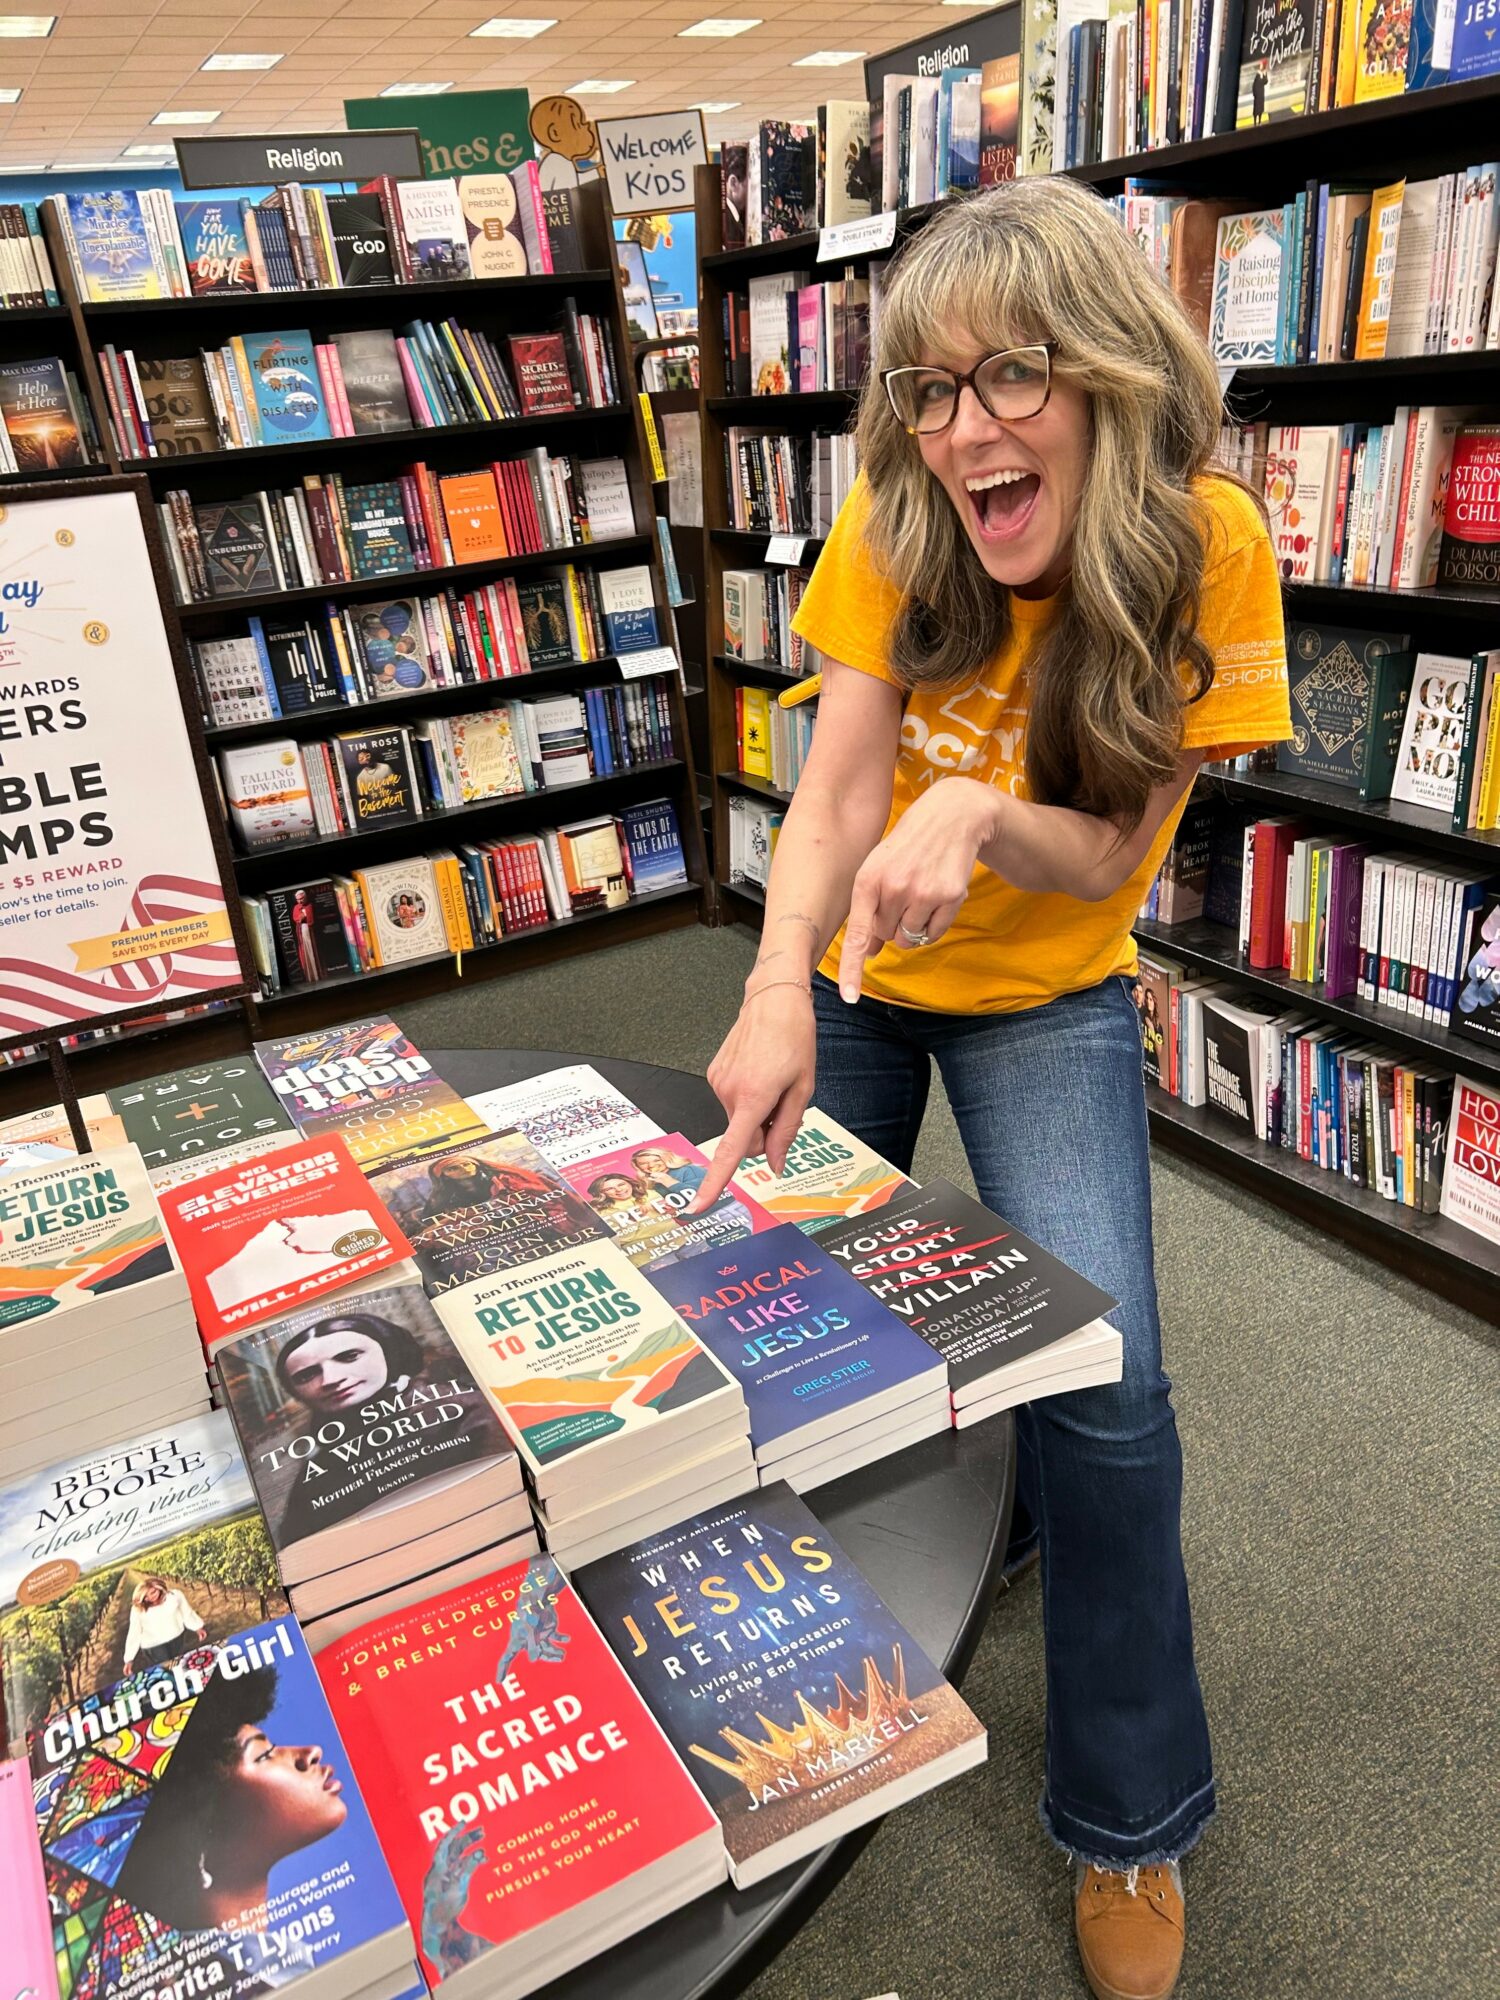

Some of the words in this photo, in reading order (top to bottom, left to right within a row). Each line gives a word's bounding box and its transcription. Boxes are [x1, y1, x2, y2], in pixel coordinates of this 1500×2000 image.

[917, 43, 969, 77] Religion
[1269, 31, 1306, 69] World
[1361, 61, 1387, 77] YOU
[266, 148, 343, 172] Religion
[493, 132, 525, 165] &
[606, 129, 697, 163] WELCOME
[981, 147, 1014, 167] LISTEN
[467, 185, 506, 197] PRIESTLY
[467, 198, 511, 209] PRESENCE
[87, 216, 129, 232] Miracles
[203, 214, 221, 224] FAR
[405, 203, 456, 220] AMISH
[195, 234, 238, 253] HAVE
[200, 222, 228, 237] YOU
[80, 237, 145, 255] Unexplainable
[352, 240, 386, 255] GOD
[480, 250, 504, 260] JOHN
[197, 254, 245, 284] COME
[484, 260, 516, 271] NUGENT
[1238, 254, 1280, 276] Raising
[1232, 292, 1246, 305] at
[1249, 285, 1280, 304] Home
[1, 365, 21, 377] MAX
[21, 363, 54, 376] LUCADO
[252, 355, 309, 370] FLIRTING
[520, 362, 558, 373] SECRETS
[18, 380, 50, 398] Help
[268, 382, 303, 394] WITH
[352, 374, 391, 386] DEEPER
[524, 383, 569, 395] DELIVERANCE
[15, 397, 27, 411] Is
[28, 394, 58, 411] Here
[261, 402, 320, 418] DISASTER
[1417, 421, 1428, 440] The
[1266, 452, 1298, 475] See
[1413, 441, 1426, 478] Mindful
[449, 504, 497, 516] RADICAL
[1407, 478, 1421, 521] Marriage
[367, 527, 392, 539] HOUSE
[464, 534, 493, 543] DAVID
[464, 539, 494, 548] PLATT
[207, 541, 265, 556] UNBURDENED
[618, 587, 646, 599] LOVE
[268, 630, 307, 643] RETHINKING
[206, 664, 258, 678] CHURCH
[208, 675, 260, 689] MEMBER
[315, 688, 337, 699] POLICE
[1312, 699, 1361, 717] SEASONS
[1315, 690, 1358, 707] SACRED
[218, 710, 269, 724] RAINER
[347, 740, 367, 752] TIM
[371, 736, 400, 750] ROSS
[239, 767, 295, 786] FALLING
[241, 777, 297, 796] UPWARD
[357, 773, 402, 797] Welcome
[357, 793, 405, 819] Basement
[626, 811, 643, 820] NEIL
[643, 804, 672, 817] SHUBIN
[252, 832, 287, 847] RICHARD
[288, 829, 311, 841] ROHR
[633, 818, 658, 841] ENDS
[659, 816, 671, 833] OF
[630, 839, 648, 859] THE
[651, 832, 679, 854] EARTH
[13, 875, 35, 890] $5
[44, 856, 124, 883] REWARD
[32, 890, 54, 905] the
[55, 886, 84, 900] time
[86, 881, 101, 893] to
[103, 875, 128, 893] join.
[442, 886, 455, 922] UNWIND
[34, 907, 53, 920] for
[55, 898, 99, 916] details.
[111, 931, 158, 949] PREMIUM
[160, 920, 209, 938] MEMBERS
[112, 946, 137, 959] SAVE
[138, 941, 158, 953] 10%
[159, 934, 190, 949] EVERY
[191, 930, 210, 942] DAY
[270, 1032, 329, 1052] FELLER
[329, 1020, 379, 1039] TYLER
[1206, 1037, 1220, 1064] THE
[120, 1067, 248, 1108] CARE
[1207, 1057, 1242, 1098] MARRIAGE
[344, 1098, 424, 1129] GOD
[1208, 1077, 1250, 1121] DEVOTIONAL
[142, 1117, 279, 1160] SOUL
[176, 1150, 337, 1217] ELEVATOR
[238, 1164, 267, 1181] NO
[212, 1161, 341, 1215] EVEREST
[14, 1194, 131, 1243] JESUS
[421, 1189, 532, 1227] TWELVE
[434, 1207, 548, 1248] WOMEN
[650, 1212, 723, 1247] WEATHERLY
[684, 1214, 750, 1248] JOHNSTON
[829, 1217, 922, 1261] YOUR
[432, 1227, 604, 1295] MACARTHUR
[472, 1233, 545, 1265] JOHN
[850, 1226, 958, 1281] STORY
[219, 1289, 297, 1326] WILL
[298, 1247, 394, 1296] ACUFF
[500, 1258, 587, 1291] Thompson
[869, 1260, 943, 1299] HAS
[474, 1267, 618, 1337] RETURN
[727, 1291, 810, 1335] LIKE
[920, 1292, 1007, 1338] JONATHAN
[487, 1335, 527, 1362] TO
[535, 1291, 642, 1351] JESUS
[740, 1307, 851, 1368] JESUS
[927, 1308, 1004, 1348] POKLUDA
[792, 1372, 834, 1398] GREG
[834, 1359, 872, 1382] STIER
[260, 1420, 347, 1474] TOO
[358, 1378, 475, 1428] SMALL
[328, 1401, 465, 1464] WORLD
[50, 1438, 183, 1500] BETH
[365, 1455, 420, 1482] FRANCES
[419, 1433, 472, 1458] CABRINI
[35, 1451, 207, 1532] MOORE
[23, 1506, 140, 1560] chasing
[640, 1522, 765, 1589] WHEN
[621, 1534, 834, 1659] JESUS
[340, 1631, 408, 1677] JOHN
[421, 1574, 549, 1637] ELDREDGE
[661, 1582, 842, 1680] RETURNS
[346, 1681, 363, 1698] &
[375, 1636, 459, 1681] BRENT
[471, 1593, 561, 1640] CURTIS
[689, 1666, 740, 1700] Living
[760, 1616, 852, 1665] Expectation
[797, 1635, 846, 1663] Times
[42, 1661, 207, 1765] Church
[216, 1623, 295, 1682] Girl
[443, 1672, 528, 1726] THE
[422, 1693, 585, 1786] SACRED
[745, 1770, 801, 1813] JAN
[803, 1707, 931, 1781] MARKELL
[418, 1719, 631, 1844] ROMANCE
[496, 1820, 556, 1856] COMING
[558, 1798, 601, 1826] HOME
[239, 1876, 320, 1924] Encourage
[485, 1868, 551, 1905] PURSUES
[229, 1899, 300, 1943] Christian
[299, 1873, 357, 1907] Women
[256, 1903, 337, 1966] Lyons
